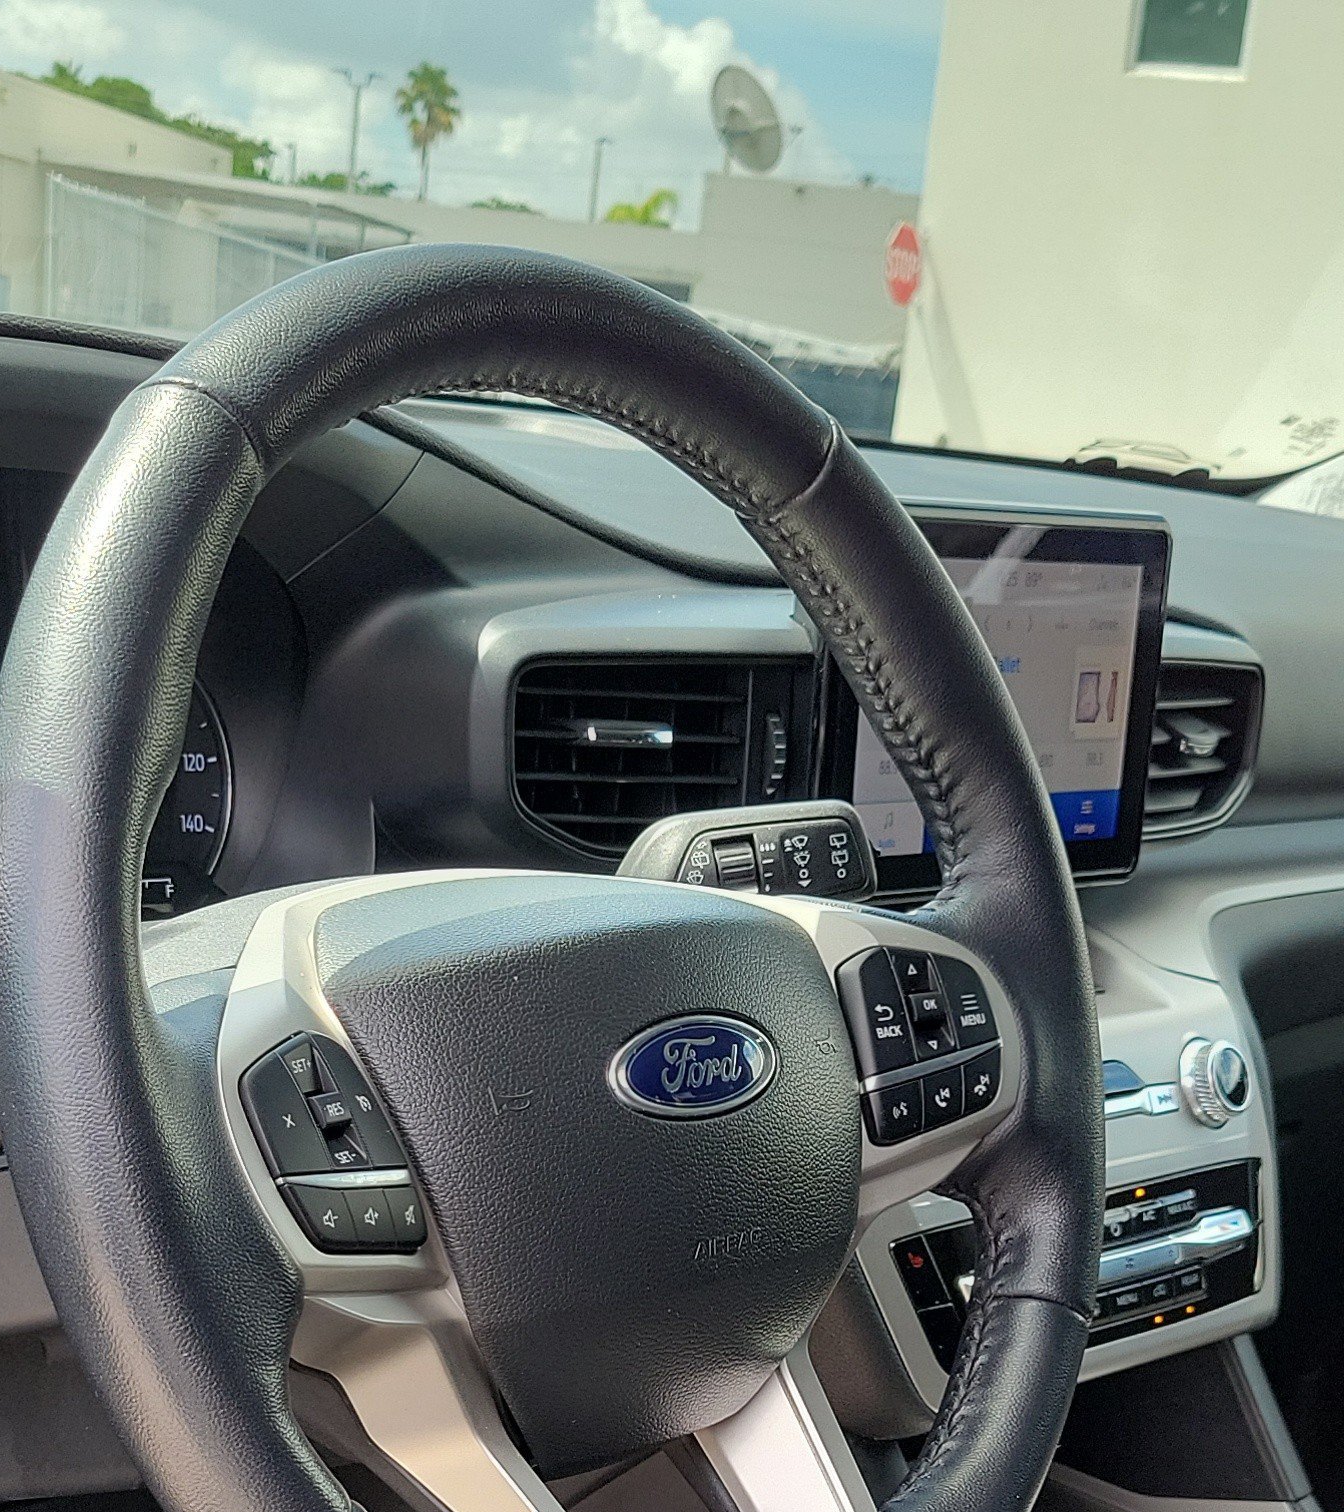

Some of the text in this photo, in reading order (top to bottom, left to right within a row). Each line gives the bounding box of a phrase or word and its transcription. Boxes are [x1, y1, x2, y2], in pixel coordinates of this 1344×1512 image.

[887, 247, 919, 281] STOP
[182, 753, 205, 772] 120
[179, 814, 204, 833] 140
[164, 884, 175, 899] F
[922, 999, 938, 1011] OK
[960, 1013, 986, 1027] MENU
[875, 1024, 904, 1039] BACK
[291, 1057, 312, 1075] SET+
[661, 1035, 743, 1093] Ford
[325, 1102, 346, 1118] RES
[334, 1151, 357, 1164] SET-
